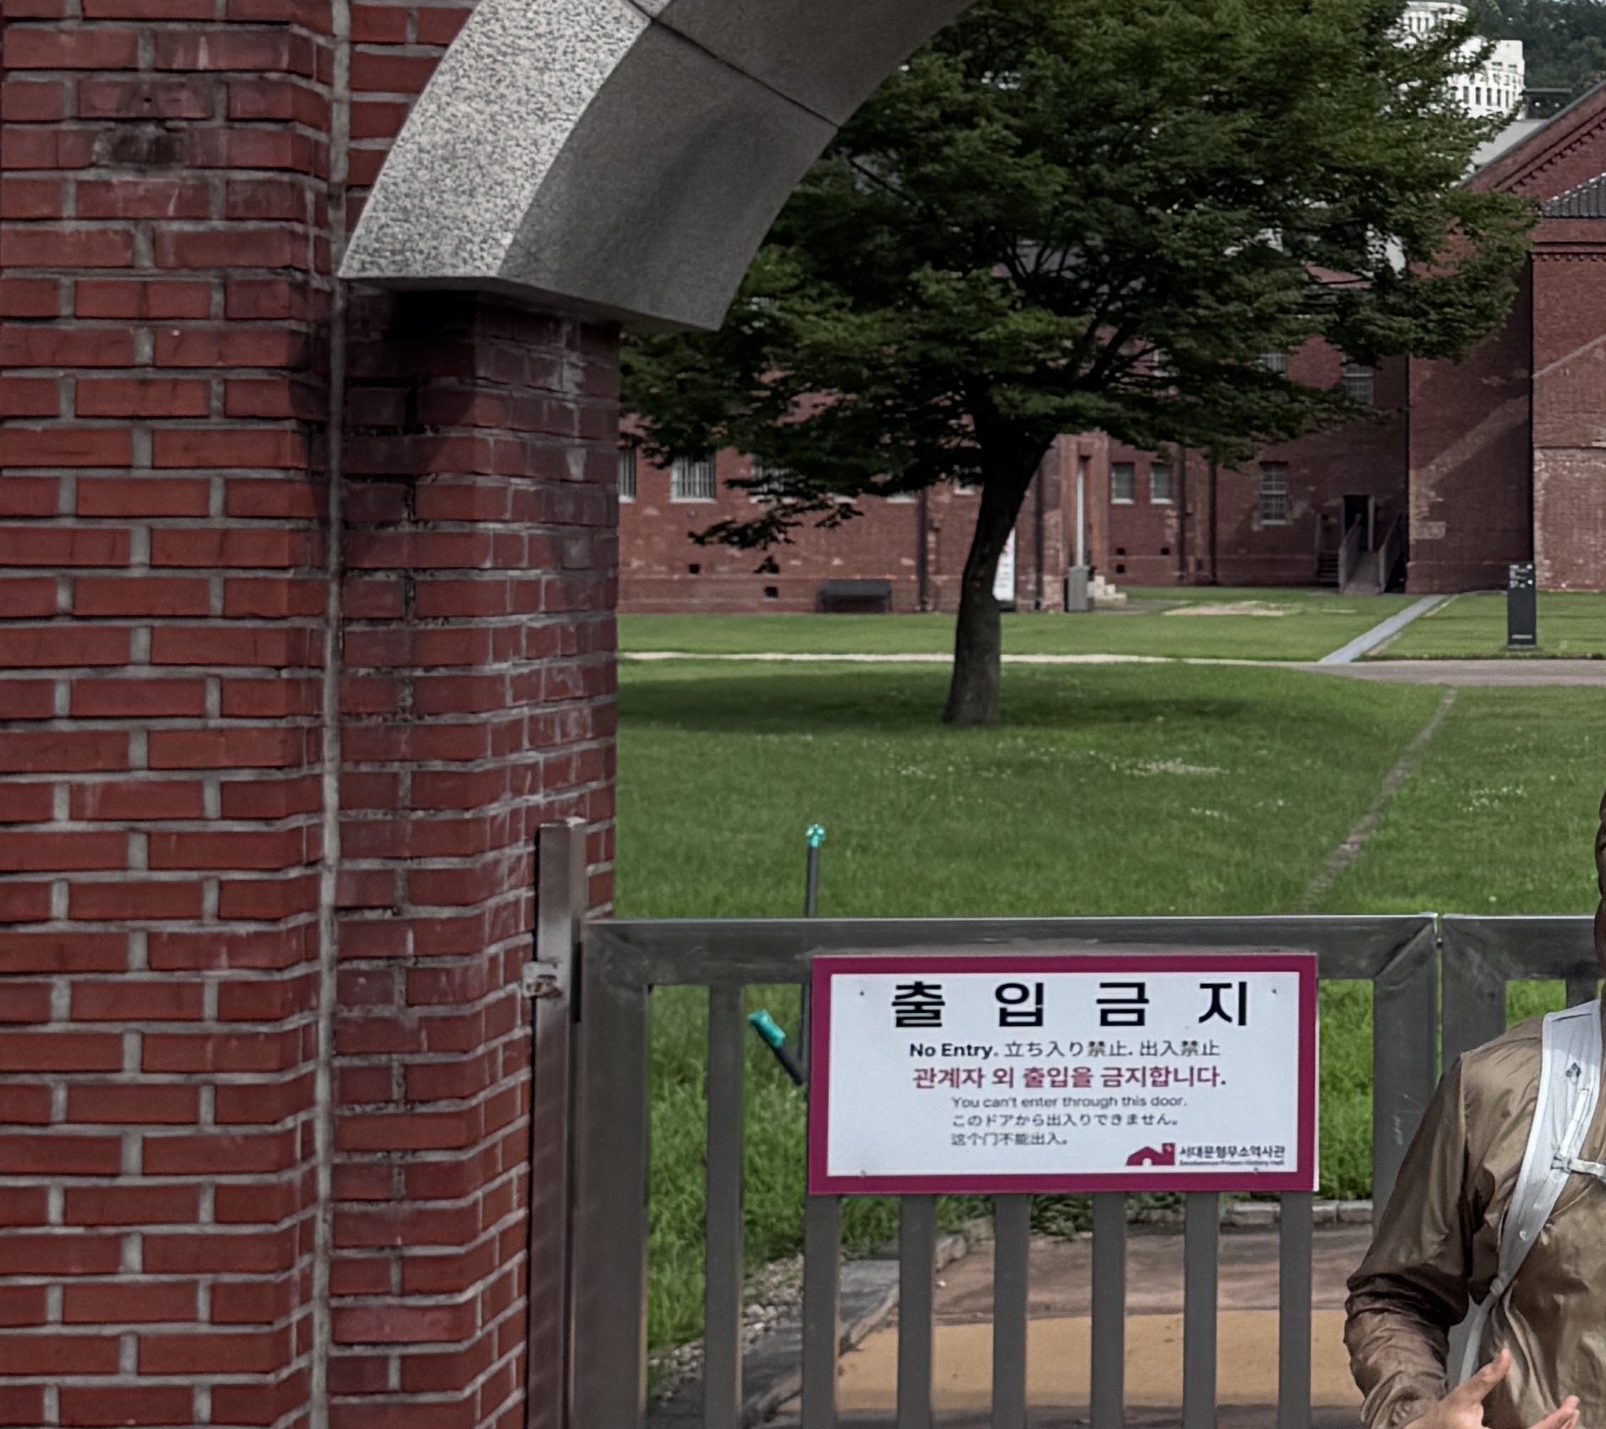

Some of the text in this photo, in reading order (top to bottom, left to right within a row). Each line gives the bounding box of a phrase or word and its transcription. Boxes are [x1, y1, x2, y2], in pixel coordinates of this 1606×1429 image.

[891, 980, 1248, 1028] 출 입 금 지
[909, 1042, 937, 1058] No
[940, 1042, 999, 1060] Entry.
[1139, 1039, 1221, 1058] 出入禁止
[912, 1065, 1228, 1090] 관계자 외 출입을 금지합니다.
[951, 1095, 1187, 1110] You can't enter through this door.
